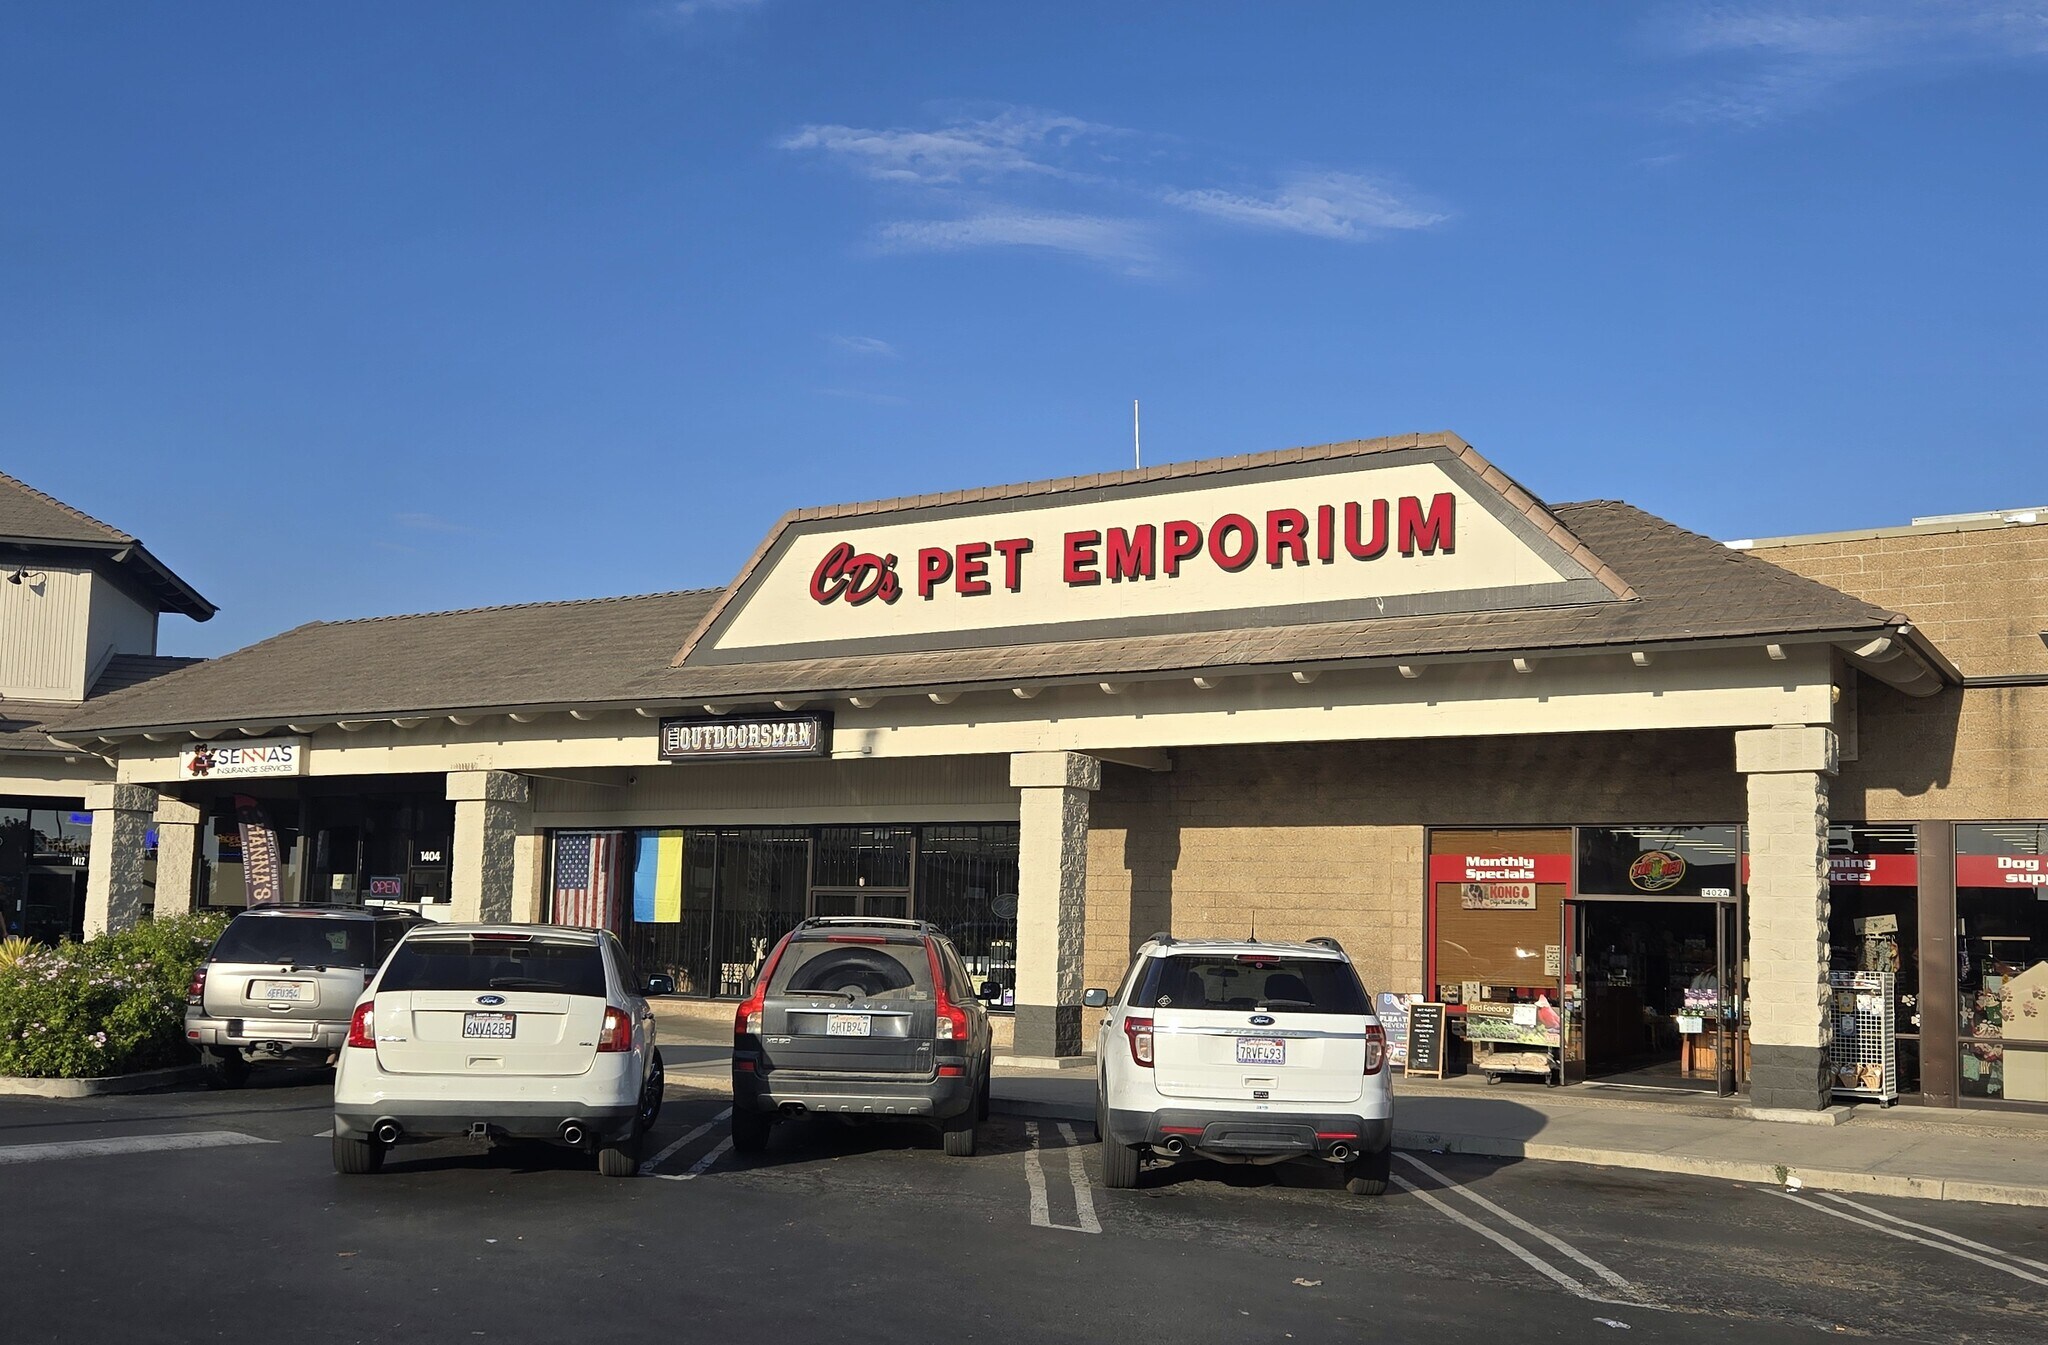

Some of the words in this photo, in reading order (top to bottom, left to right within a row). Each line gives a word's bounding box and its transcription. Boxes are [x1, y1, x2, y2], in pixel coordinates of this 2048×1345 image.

[918, 538, 1033, 601] PET
[1063, 492, 1456, 587] EMPORIUM
[668, 728, 680, 750] THE
[680, 722, 812, 750] OUTDOORSMAN
[217, 765, 258, 775] INSURANCE
[260, 764, 292, 773] SERVICES
[420, 851, 441, 862] 1404
[1465, 856, 1535, 869] Monthly
[1829, 857, 1877, 871] ming
[1997, 856, 2040, 872] Dog
[1465, 868, 1535, 881] Specials
[1830, 870, 1871, 882] ices
[2005, 873, 2048, 886] sup
[371, 881, 399, 893] OPEN
[1489, 886, 1520, 898] KONG
[1702, 889, 1728, 897] 1402A
[481, 996, 499, 1004] Ford
[811, 1002, 888, 1010] VOLVO
[1469, 1003, 1482, 1012] Bird
[1483, 1004, 1511, 1015] Feeding
[1253, 1016, 1270, 1024] Ford
[1379, 1015, 1398, 1023] FLEA
[466, 1021, 512, 1036] 6NVA285
[830, 1021, 868, 1034] 6HTB947
[1240, 1046, 1282, 1060] 7RVF493
